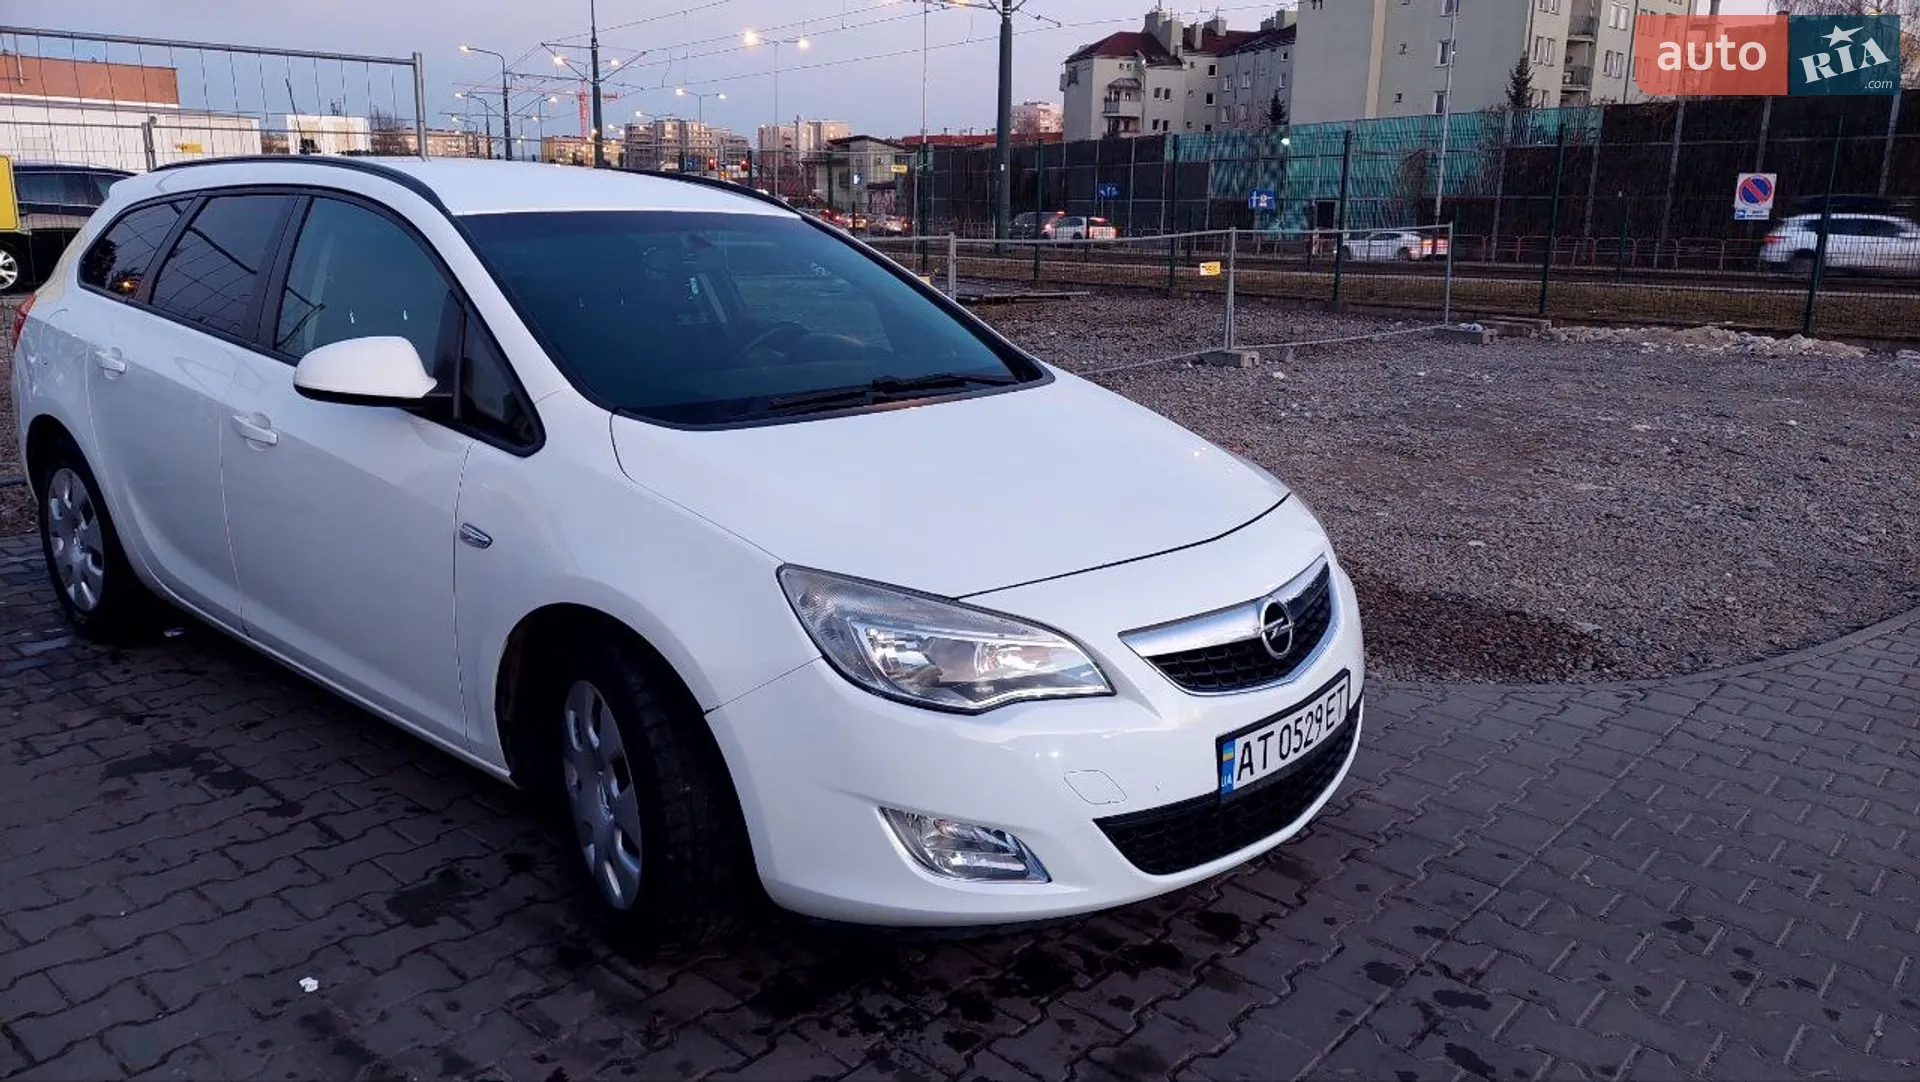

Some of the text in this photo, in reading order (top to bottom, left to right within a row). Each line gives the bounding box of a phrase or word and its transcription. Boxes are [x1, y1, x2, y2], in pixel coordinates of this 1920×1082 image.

[1237, 683, 1346, 781] AT 0529 ET
[1221, 773, 1233, 787] UA
